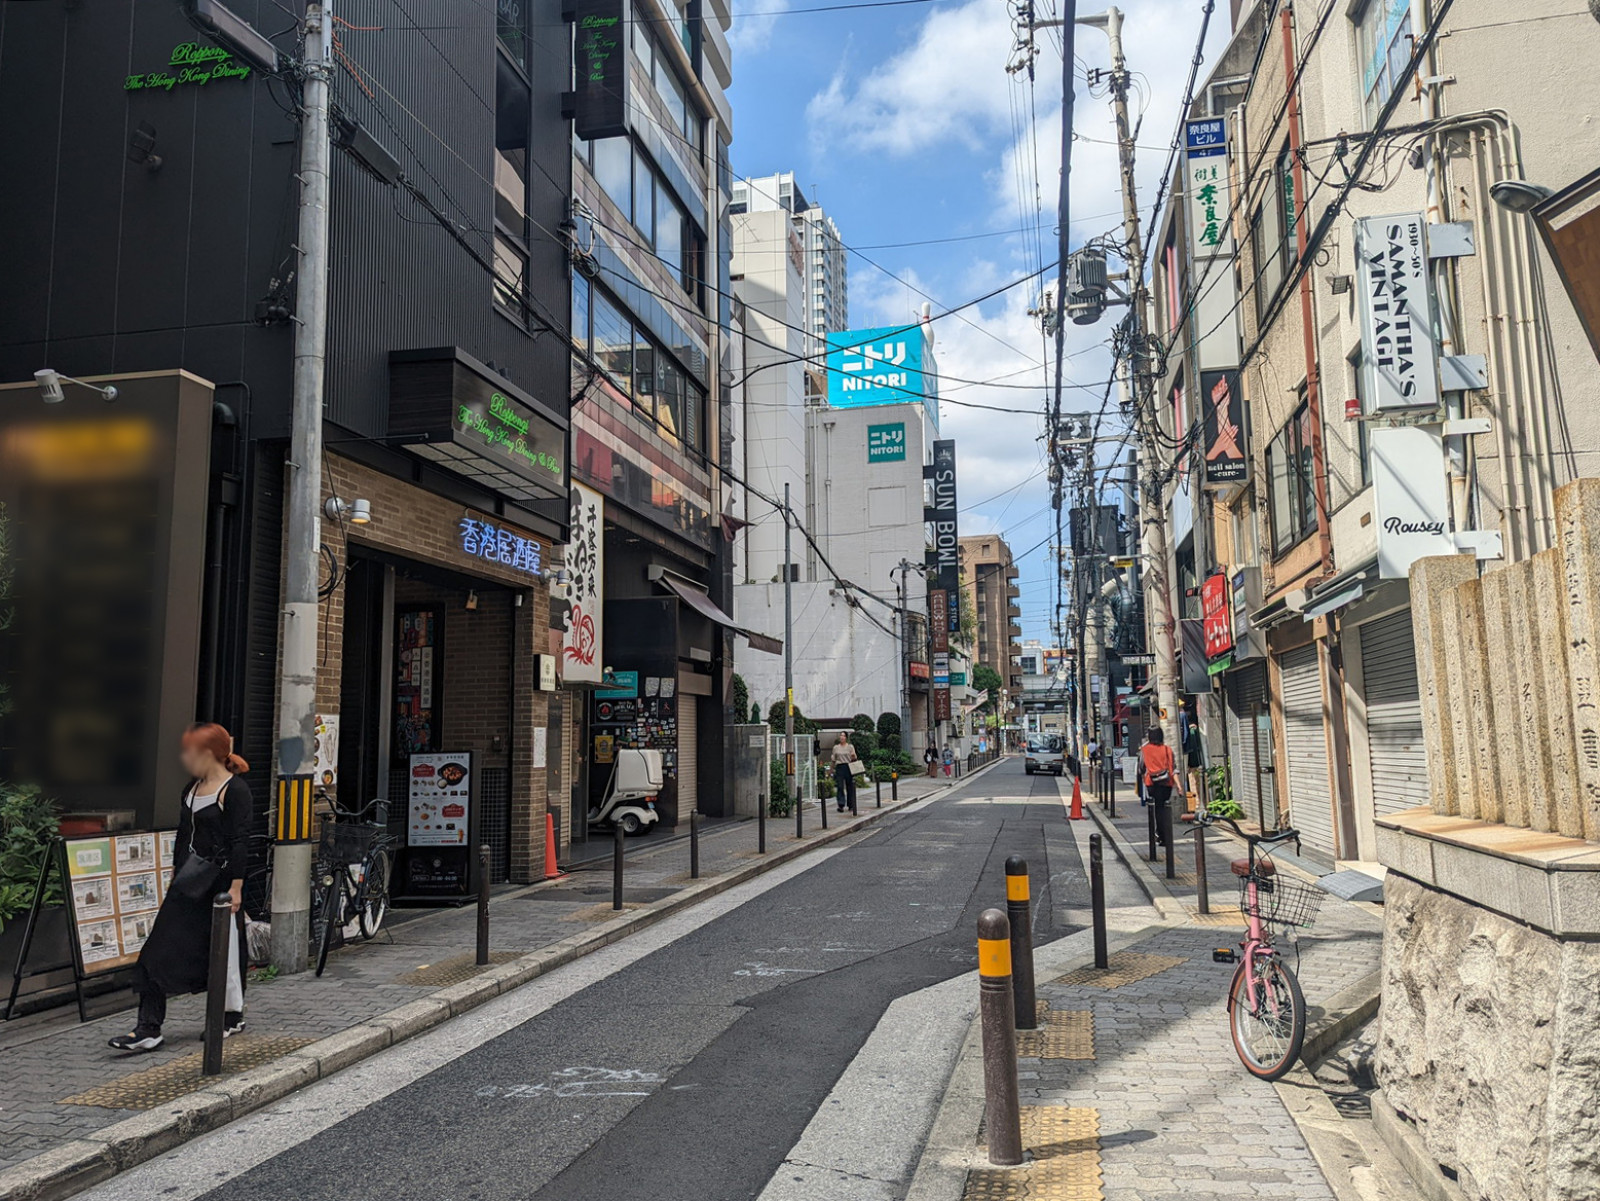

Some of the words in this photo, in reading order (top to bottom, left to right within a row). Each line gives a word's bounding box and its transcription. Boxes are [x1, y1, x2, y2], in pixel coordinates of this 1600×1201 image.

[169, 42, 231, 64] Roppong
[123, 74, 144, 89] The
[144, 72, 176, 90] Hong
[178, 67, 211, 85] Kong
[212, 61, 250, 79] Dining
[1189, 122, 1221, 135] 奈良屋
[1196, 134, 1217, 145] ビル
[1196, 183, 1222, 247] 奈良屋
[1369, 251, 1395, 373] VINTAGE
[1386, 224, 1417, 398] SAMANTHA'S
[842, 342, 906, 372] ニトリ
[842, 372, 907, 391] NITORI
[489, 393, 530, 435] Roppongi
[458, 405, 473, 426] The
[473, 413, 494, 443] Hong
[494, 426, 514, 454] Kong
[515, 438, 537, 466] Dining
[870, 430, 903, 446] ニトリ
[870, 446, 903, 456] NITORI
[1224, 462, 1245, 470] salon
[936, 469, 955, 511] SUN
[1383, 517, 1445, 536] Rousey
[459, 517, 542, 577] 香港居酒屋
[937, 520, 956, 575] BOWL
